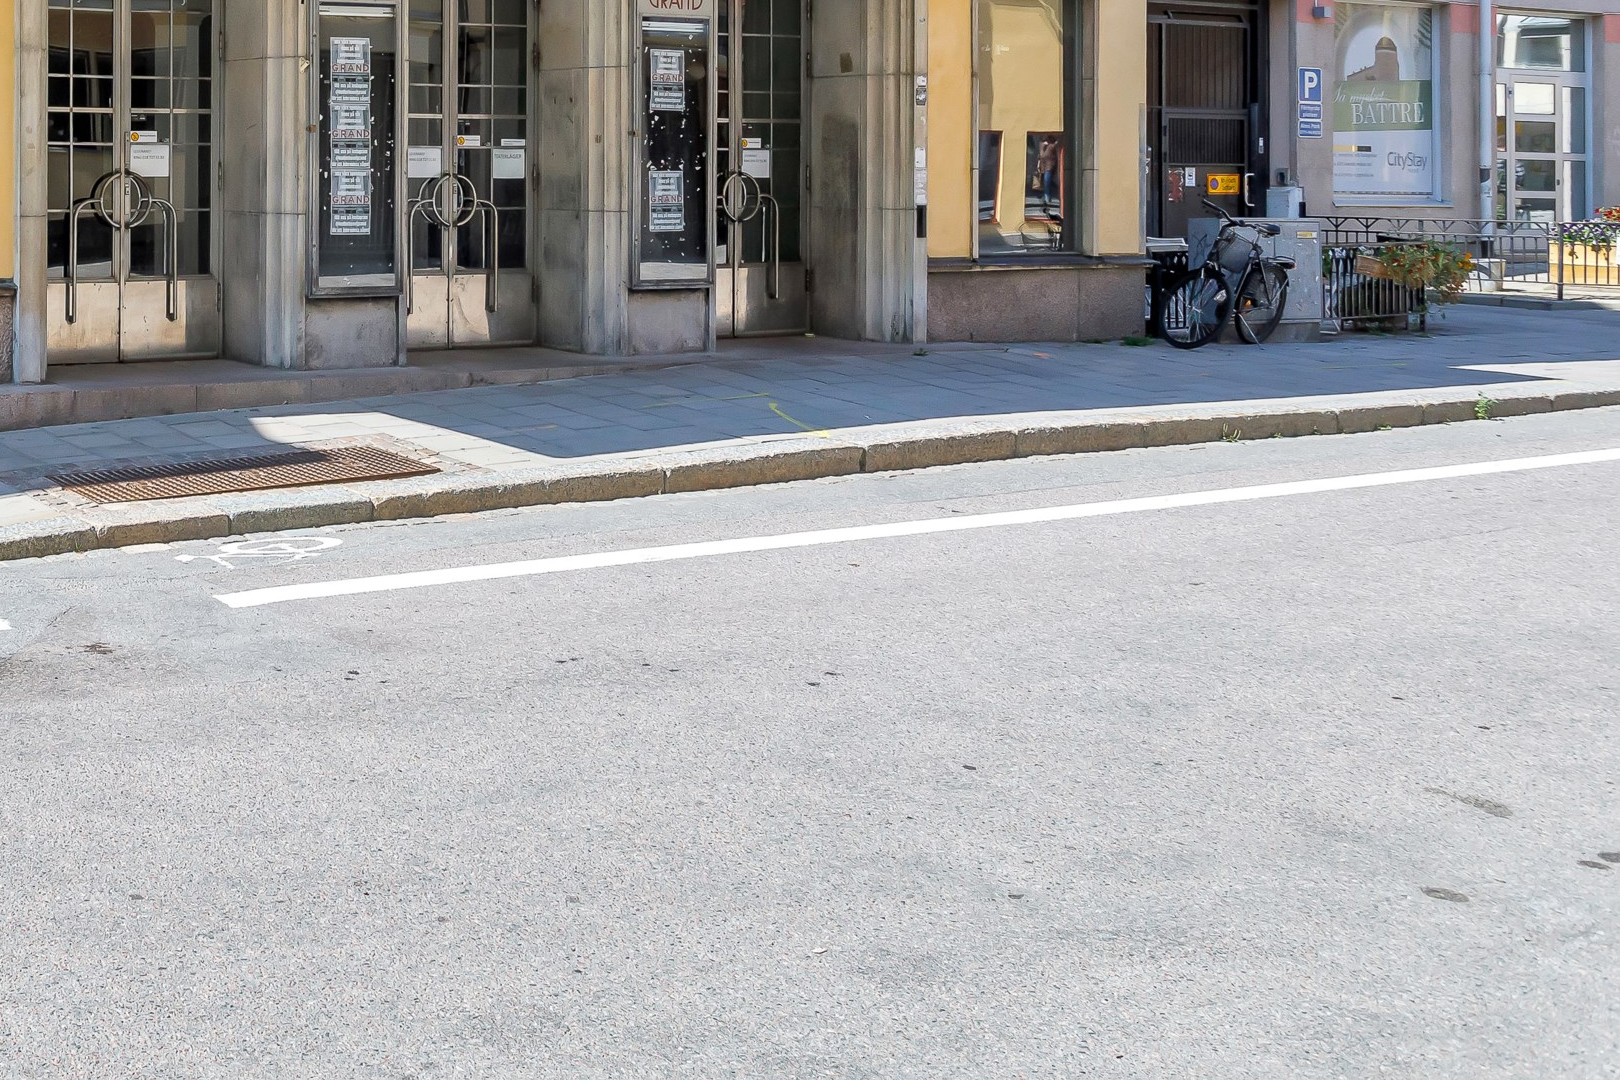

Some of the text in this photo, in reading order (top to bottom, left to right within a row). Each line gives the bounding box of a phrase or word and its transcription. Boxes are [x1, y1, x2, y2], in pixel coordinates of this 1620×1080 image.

[332, 63, 370, 72] GRAND
[652, 73, 684, 82] GRAND
[1304, 71, 1318, 99] P
[332, 130, 370, 138] GRAND
[1386, 151, 1428, 171] CityStay
[332, 196, 370, 204] GRAND
[651, 195, 683, 203] GRAND
